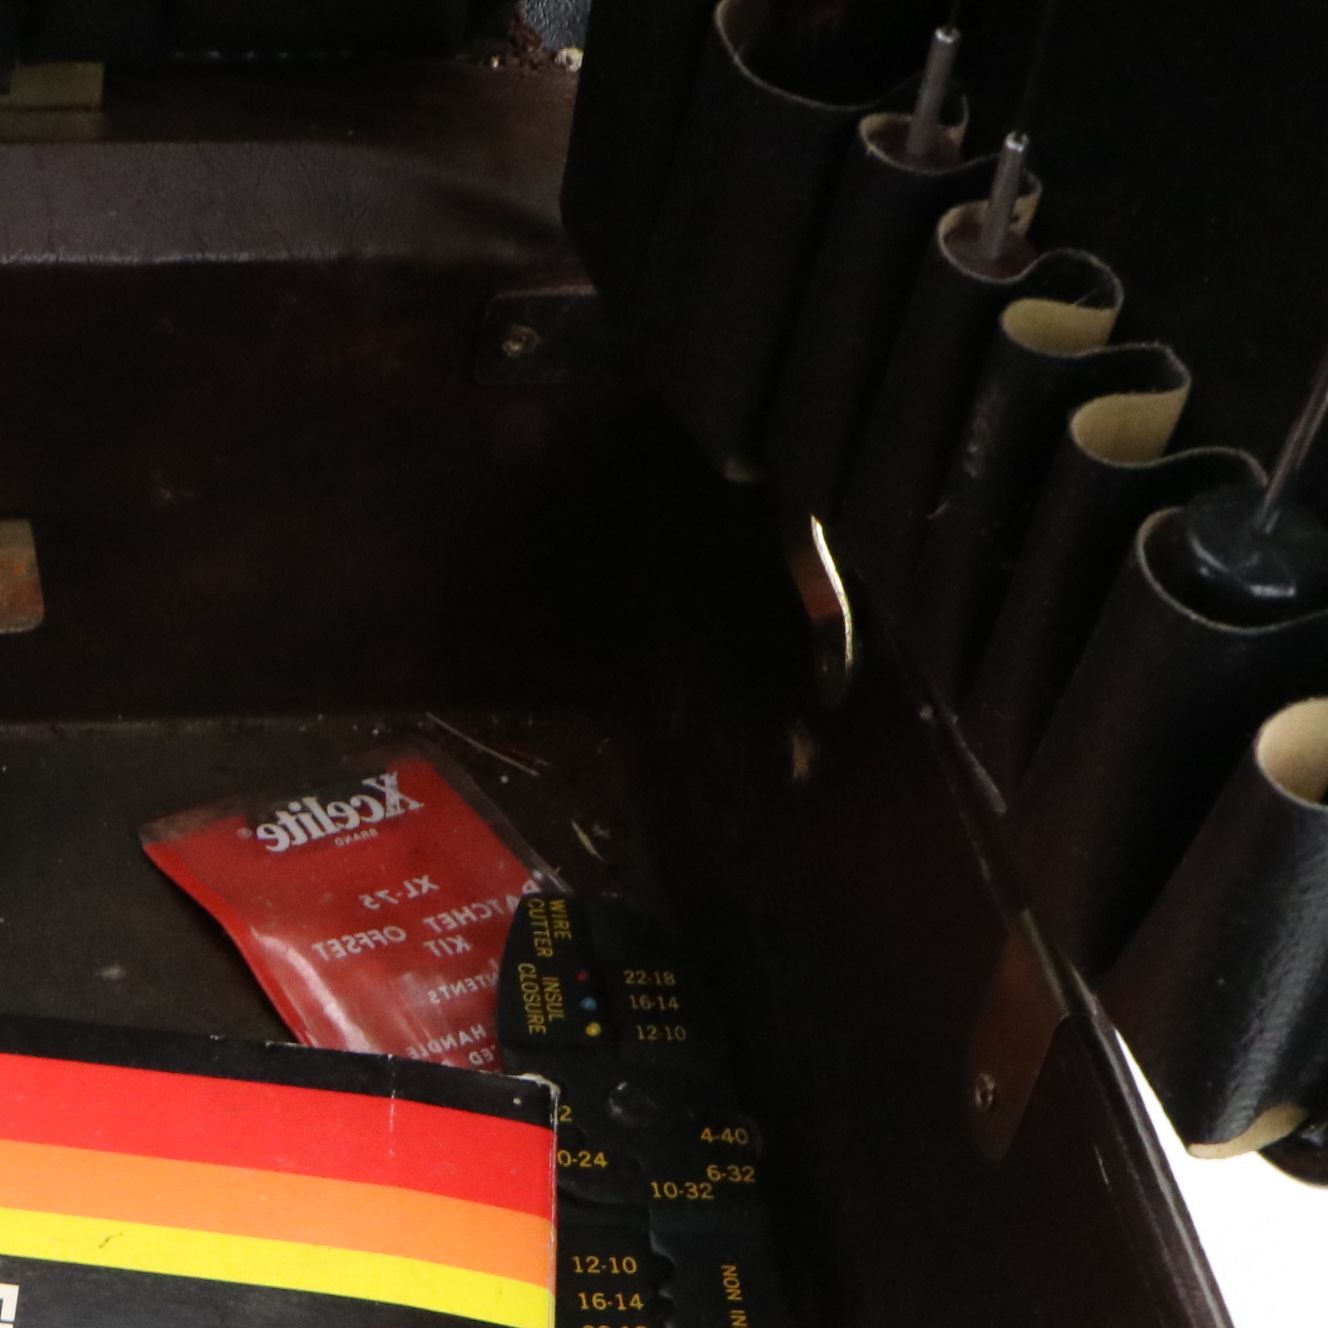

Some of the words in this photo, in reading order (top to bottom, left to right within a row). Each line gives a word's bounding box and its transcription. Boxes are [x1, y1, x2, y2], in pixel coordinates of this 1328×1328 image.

[527, 898, 553, 958] CUTTER
[548, 898, 572, 941] WIRE
[518, 962, 547, 1035] CLOSURE
[542, 976, 565, 1022] INSUL
[700, 1126, 749, 1145] 4-40
[556, 1149, 608, 1168] 0-24
[706, 1165, 756, 1183] 6-32
[650, 1181, 714, 1200] 10-32
[572, 1256, 638, 1275] 12-10
[721, 1264, 743, 1302] NON
[578, 1292, 645, 1311] 16-14
